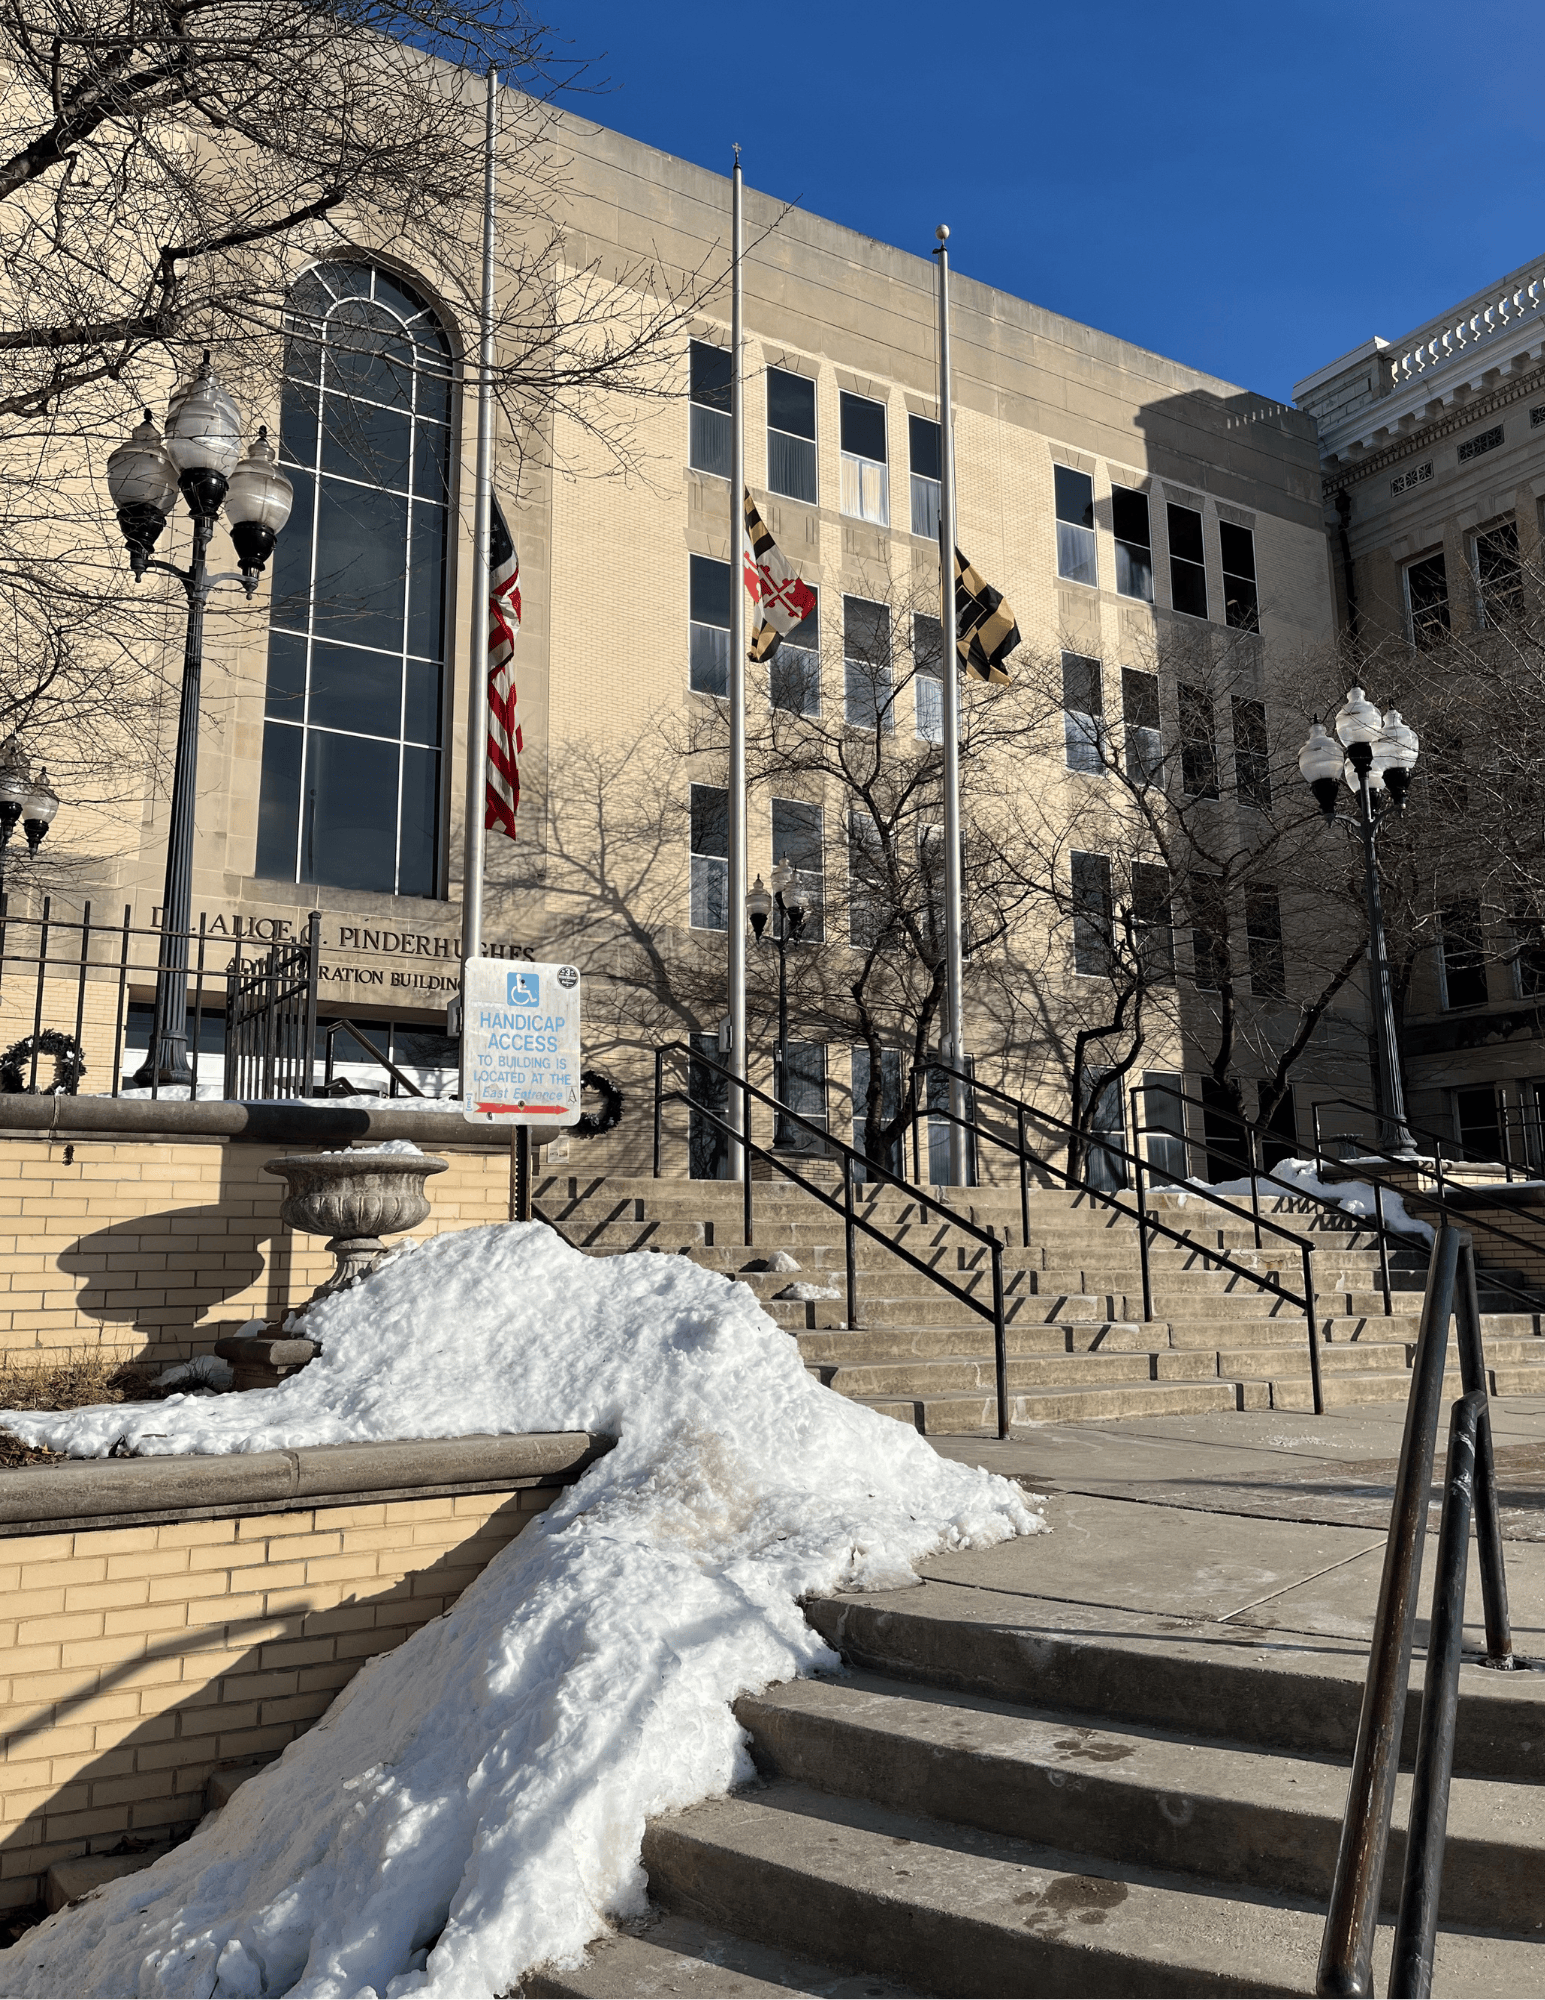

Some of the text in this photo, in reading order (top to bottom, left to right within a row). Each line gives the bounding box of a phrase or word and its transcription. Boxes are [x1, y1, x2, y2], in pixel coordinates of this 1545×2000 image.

[390, 972, 462, 992] BUILDIN
[480, 1011, 565, 1032] HANDICAP
[488, 1033, 558, 1052] ACCESS
[478, 1055, 567, 1070] TO BUILDING IS
[473, 1070, 571, 1085] LOCATED AT THE
[482, 1086, 563, 1100] East Entrance
